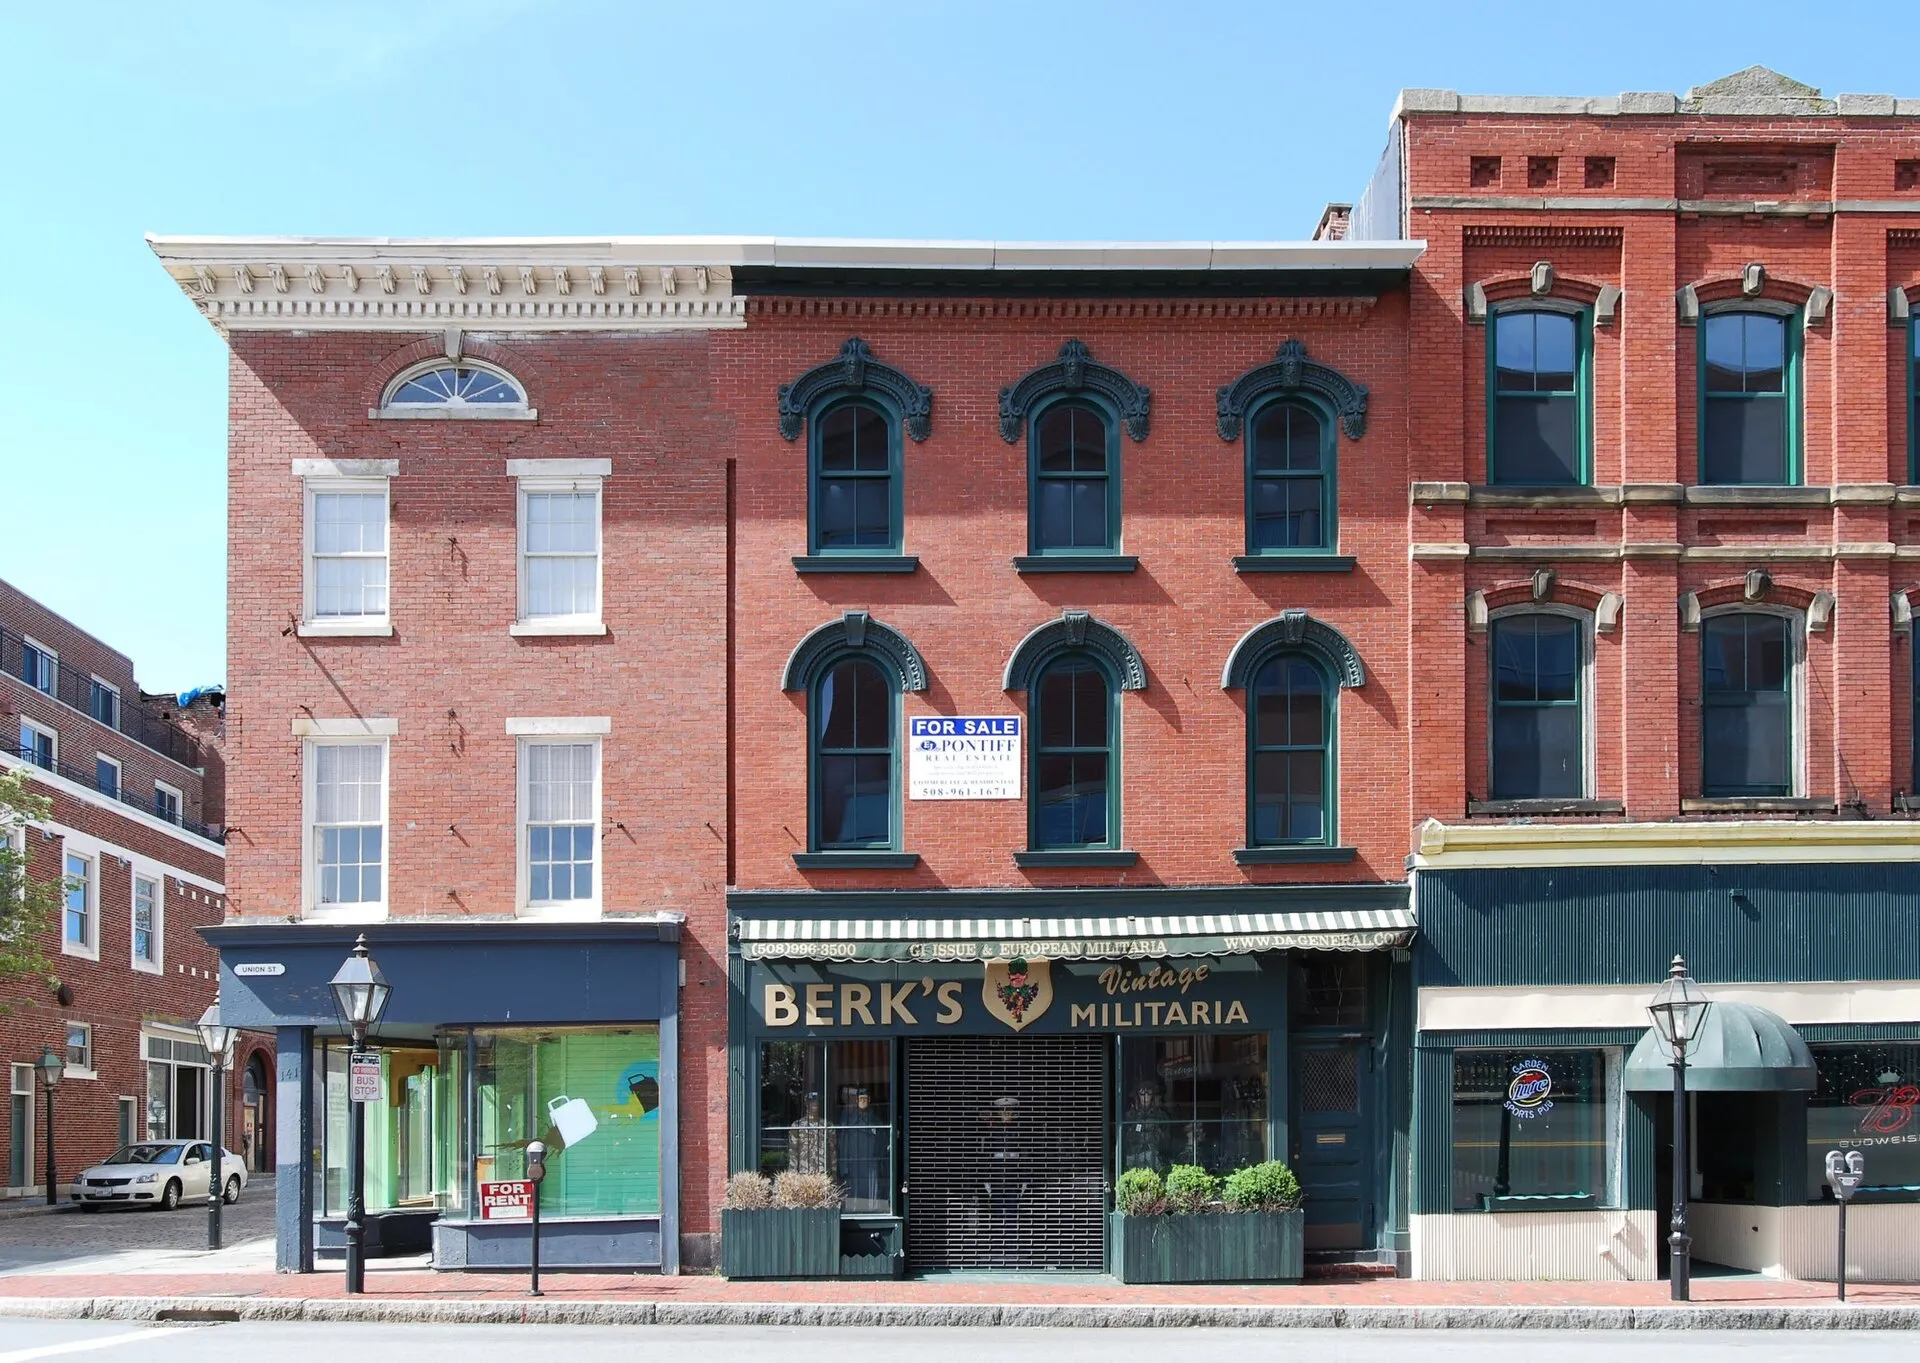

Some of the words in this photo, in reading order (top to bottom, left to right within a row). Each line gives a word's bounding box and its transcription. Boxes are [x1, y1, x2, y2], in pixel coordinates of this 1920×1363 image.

[916, 720, 956, 735] FOR
[964, 720, 1015, 735] SALE
[942, 739, 1017, 752] PONTIFF
[926, 754, 957, 762] REAL
[966, 754, 1013, 762] ESTATE
[922, 787, 1007, 797] 508-961-1671
[751, 942, 857, 957] (508)996-3500
[932, 943, 977, 957] ISSUE
[982, 943, 994, 956] &
[1000, 942, 1081, 956] EUROPEAN
[1086, 940, 1167, 955] MILITARIA
[1098, 964, 1209, 995] Vintage
[765, 976, 963, 1027] BERK'S
[1071, 1000, 1250, 1028] MILITARIA
[1511, 1059, 1550, 1074] GARDEN
[356, 1076, 375, 1086] BUS
[354, 1086, 377, 1095] STOP
[1503, 1101, 1535, 1119] SPORTS
[1537, 1100, 1554, 1116] PUB
[1839, 1134, 1920, 1148] BUDWEIS
[488, 1183, 525, 1195] FOR
[484, 1194, 531, 1207] RENT
